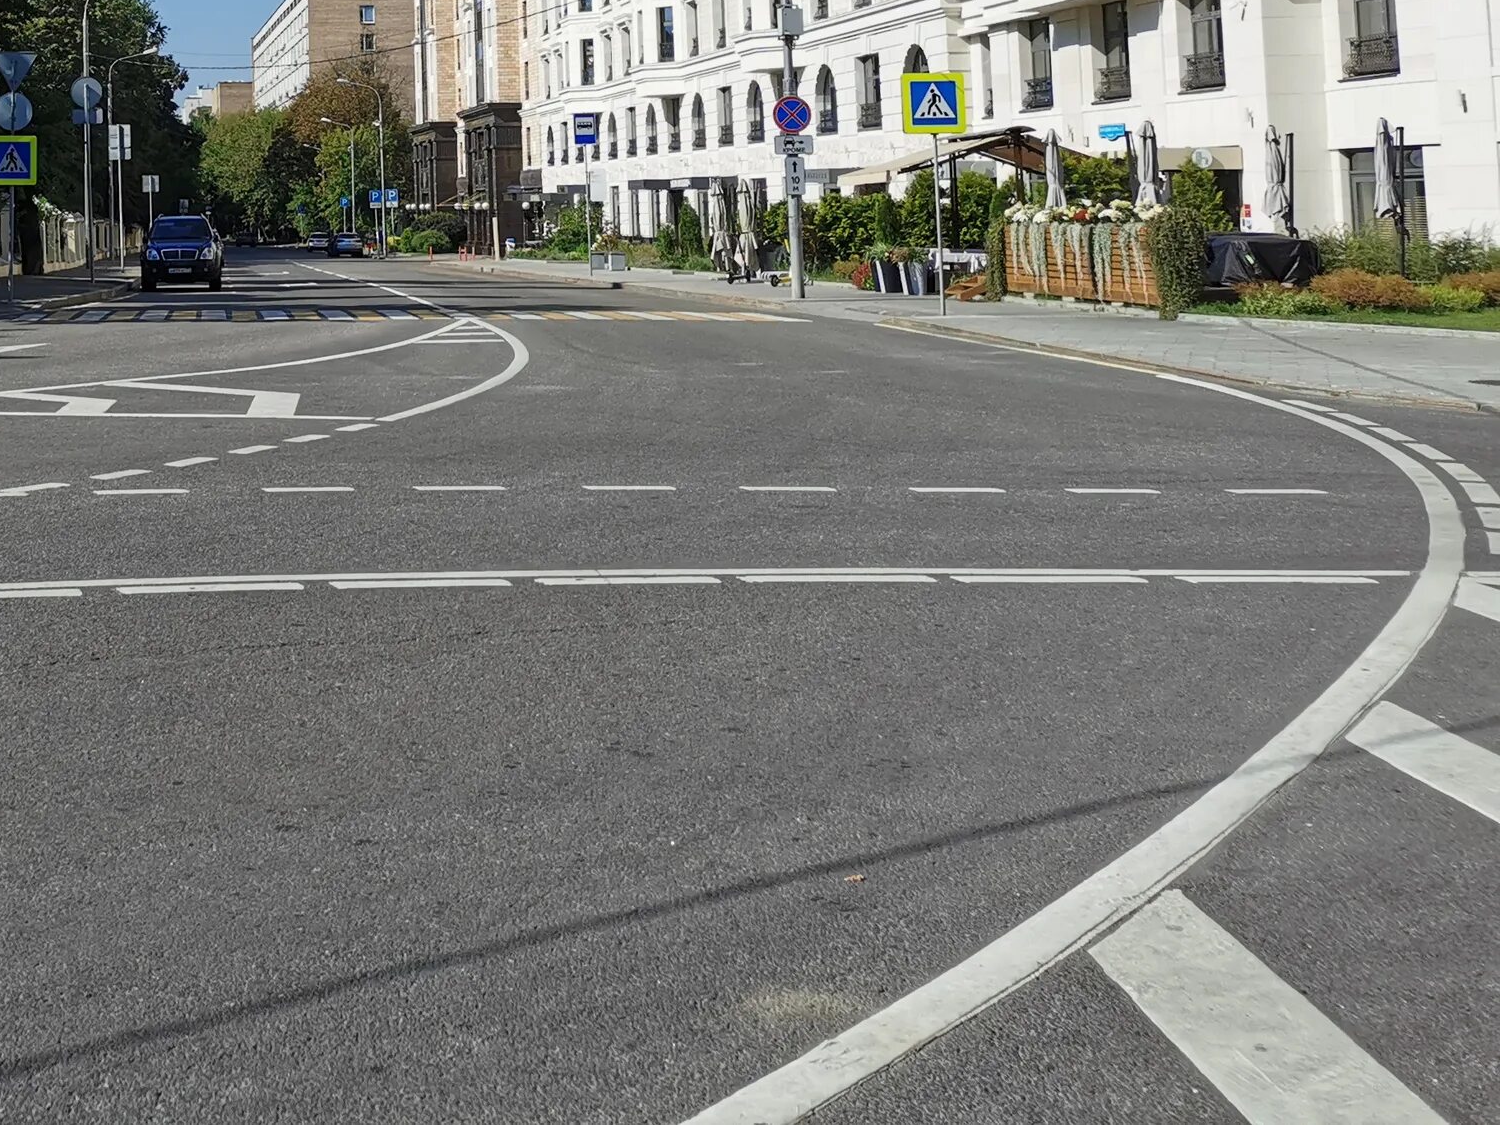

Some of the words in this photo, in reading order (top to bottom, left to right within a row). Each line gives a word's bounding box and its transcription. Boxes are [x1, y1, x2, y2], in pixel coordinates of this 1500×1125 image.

[791, 176, 800, 184] 10
[372, 192, 379, 201] P
[388, 190, 396, 200] P
